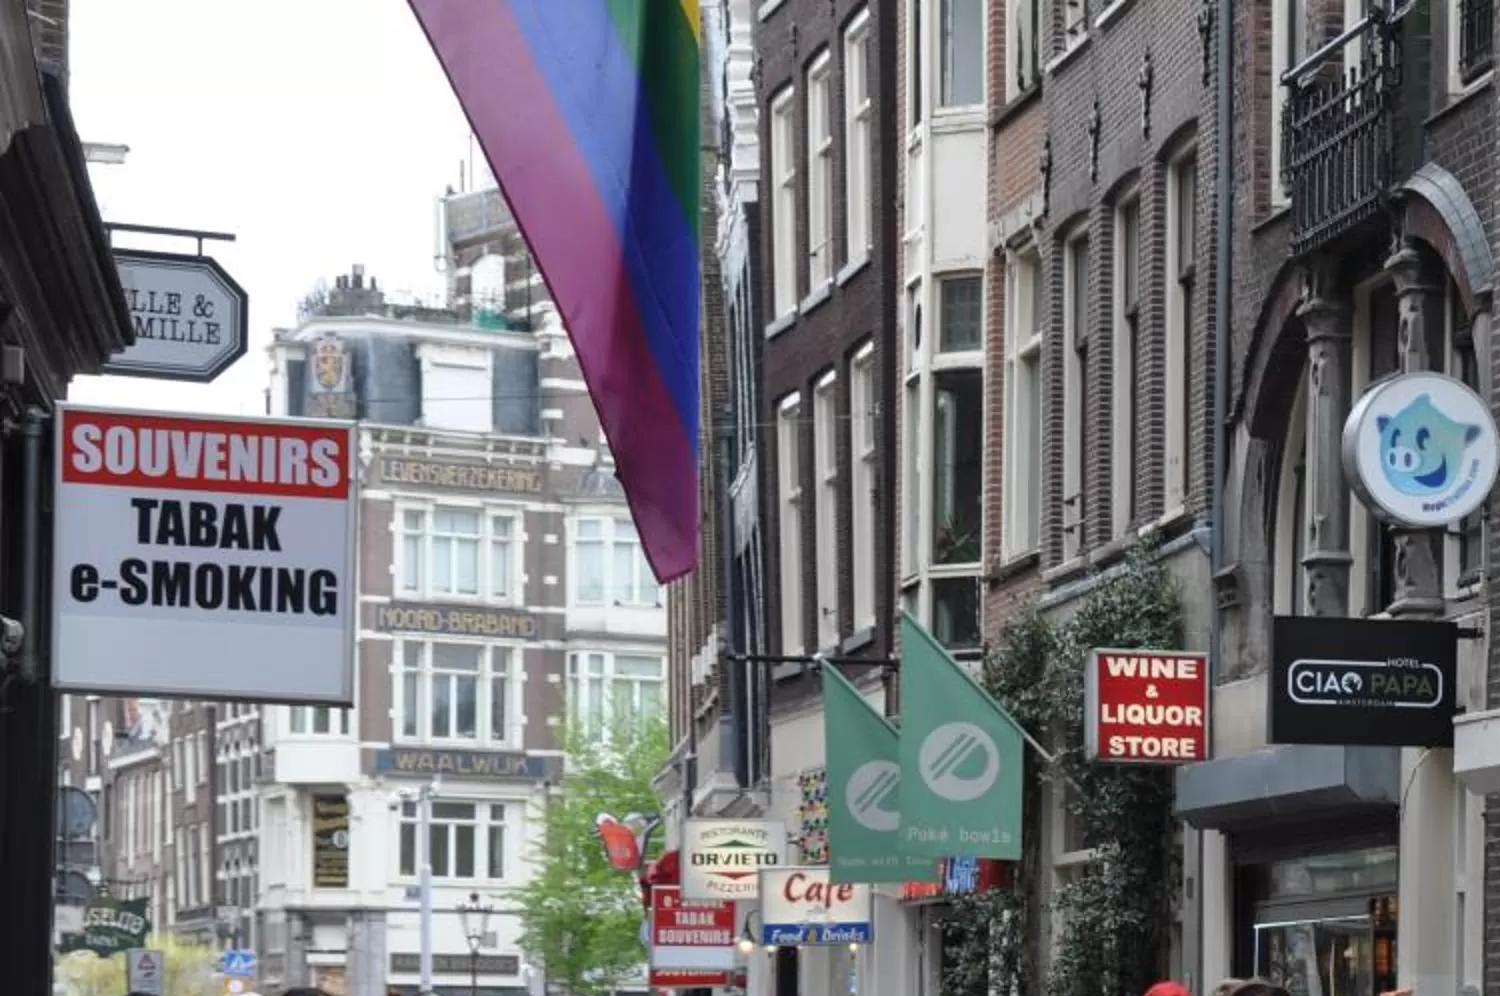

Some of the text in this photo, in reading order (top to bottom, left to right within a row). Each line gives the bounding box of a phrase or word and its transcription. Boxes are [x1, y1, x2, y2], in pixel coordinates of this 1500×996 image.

[123, 289, 214, 318] LLE &
[71, 423, 340, 488] SOUVENIRS
[131, 497, 282, 552] TABAK
[70, 558, 338, 616] e-SMOKING
[1106, 656, 1199, 680] WINE
[1387, 657, 1420, 670] HOTEL
[1145, 684, 1159, 699] &
[1296, 670, 1434, 697] CIAO PAPA
[1101, 703, 1202, 727] LIQUOR
[1108, 735, 1196, 758] STORE
[690, 852, 779, 866] ORVIETO
